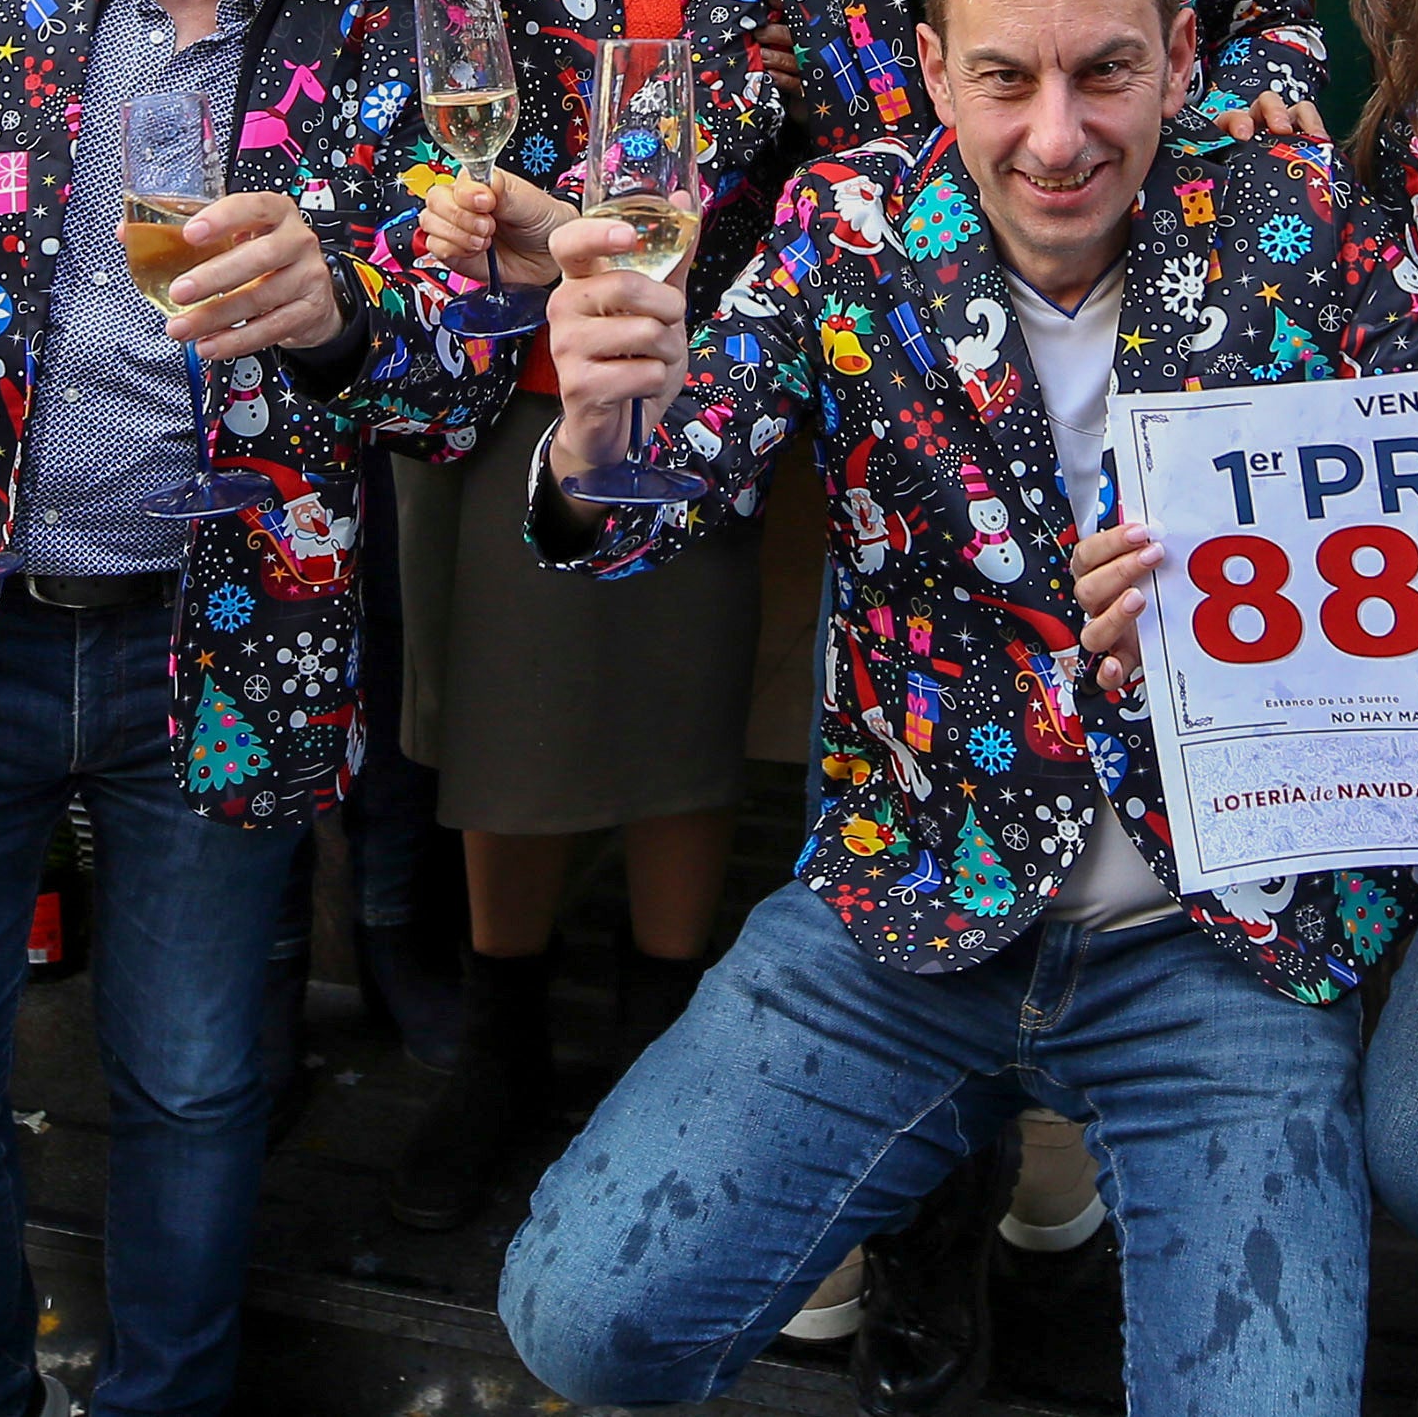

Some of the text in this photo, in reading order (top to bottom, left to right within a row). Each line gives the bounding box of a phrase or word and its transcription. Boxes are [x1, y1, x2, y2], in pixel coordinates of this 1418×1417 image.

[1265, 692, 1401, 709] Estanco De La Suerte
[1331, 712, 1356, 724] NO
[1360, 710, 1394, 723] HAY
[1212, 781, 1306, 814] LOTERÍA
